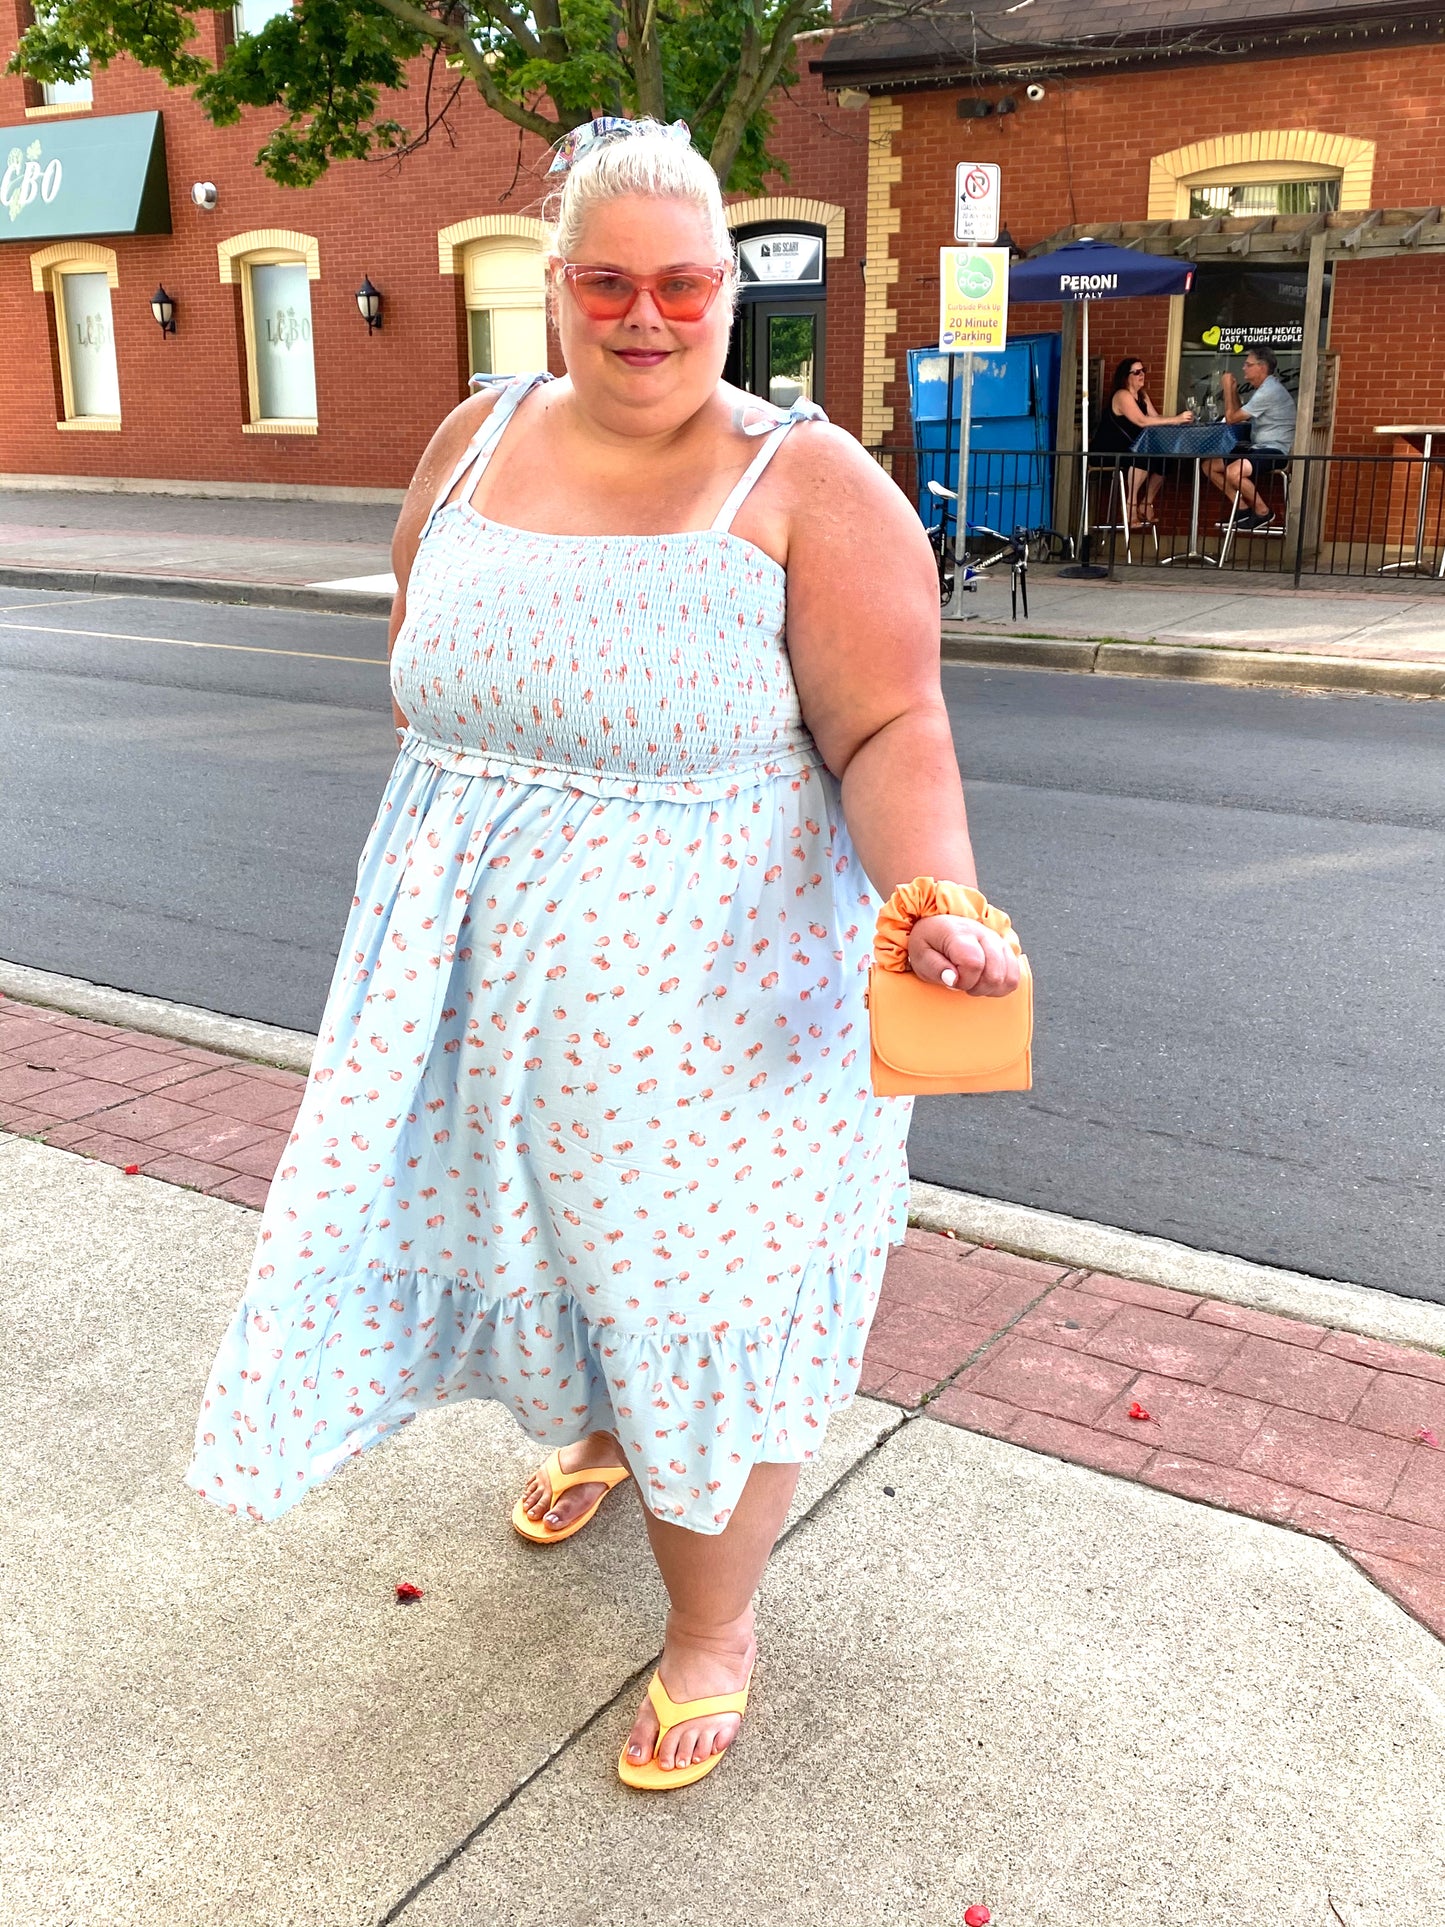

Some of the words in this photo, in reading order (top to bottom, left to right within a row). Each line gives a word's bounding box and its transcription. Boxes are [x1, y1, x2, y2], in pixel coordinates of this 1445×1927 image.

[772, 242, 782, 253] BIG
[1060, 273, 1118, 291] PERONI
[1074, 292, 1103, 300] ITALY
[947, 303, 976, 311] Curbside
[977, 303, 991, 311] Pick
[992, 303, 1001, 311] Up
[949, 317, 962, 328] 20
[965, 317, 998, 328] Minute
[265, 318, 310, 342] LCBO
[1220, 327, 1247, 335] TOUGH
[1249, 327, 1273, 335] TIMES
[1274, 326, 1303, 334] NEVER
[954, 330, 992, 343] Parking
[1220, 335, 1241, 343] LAST,
[1271, 334, 1303, 342] PEOPLE
